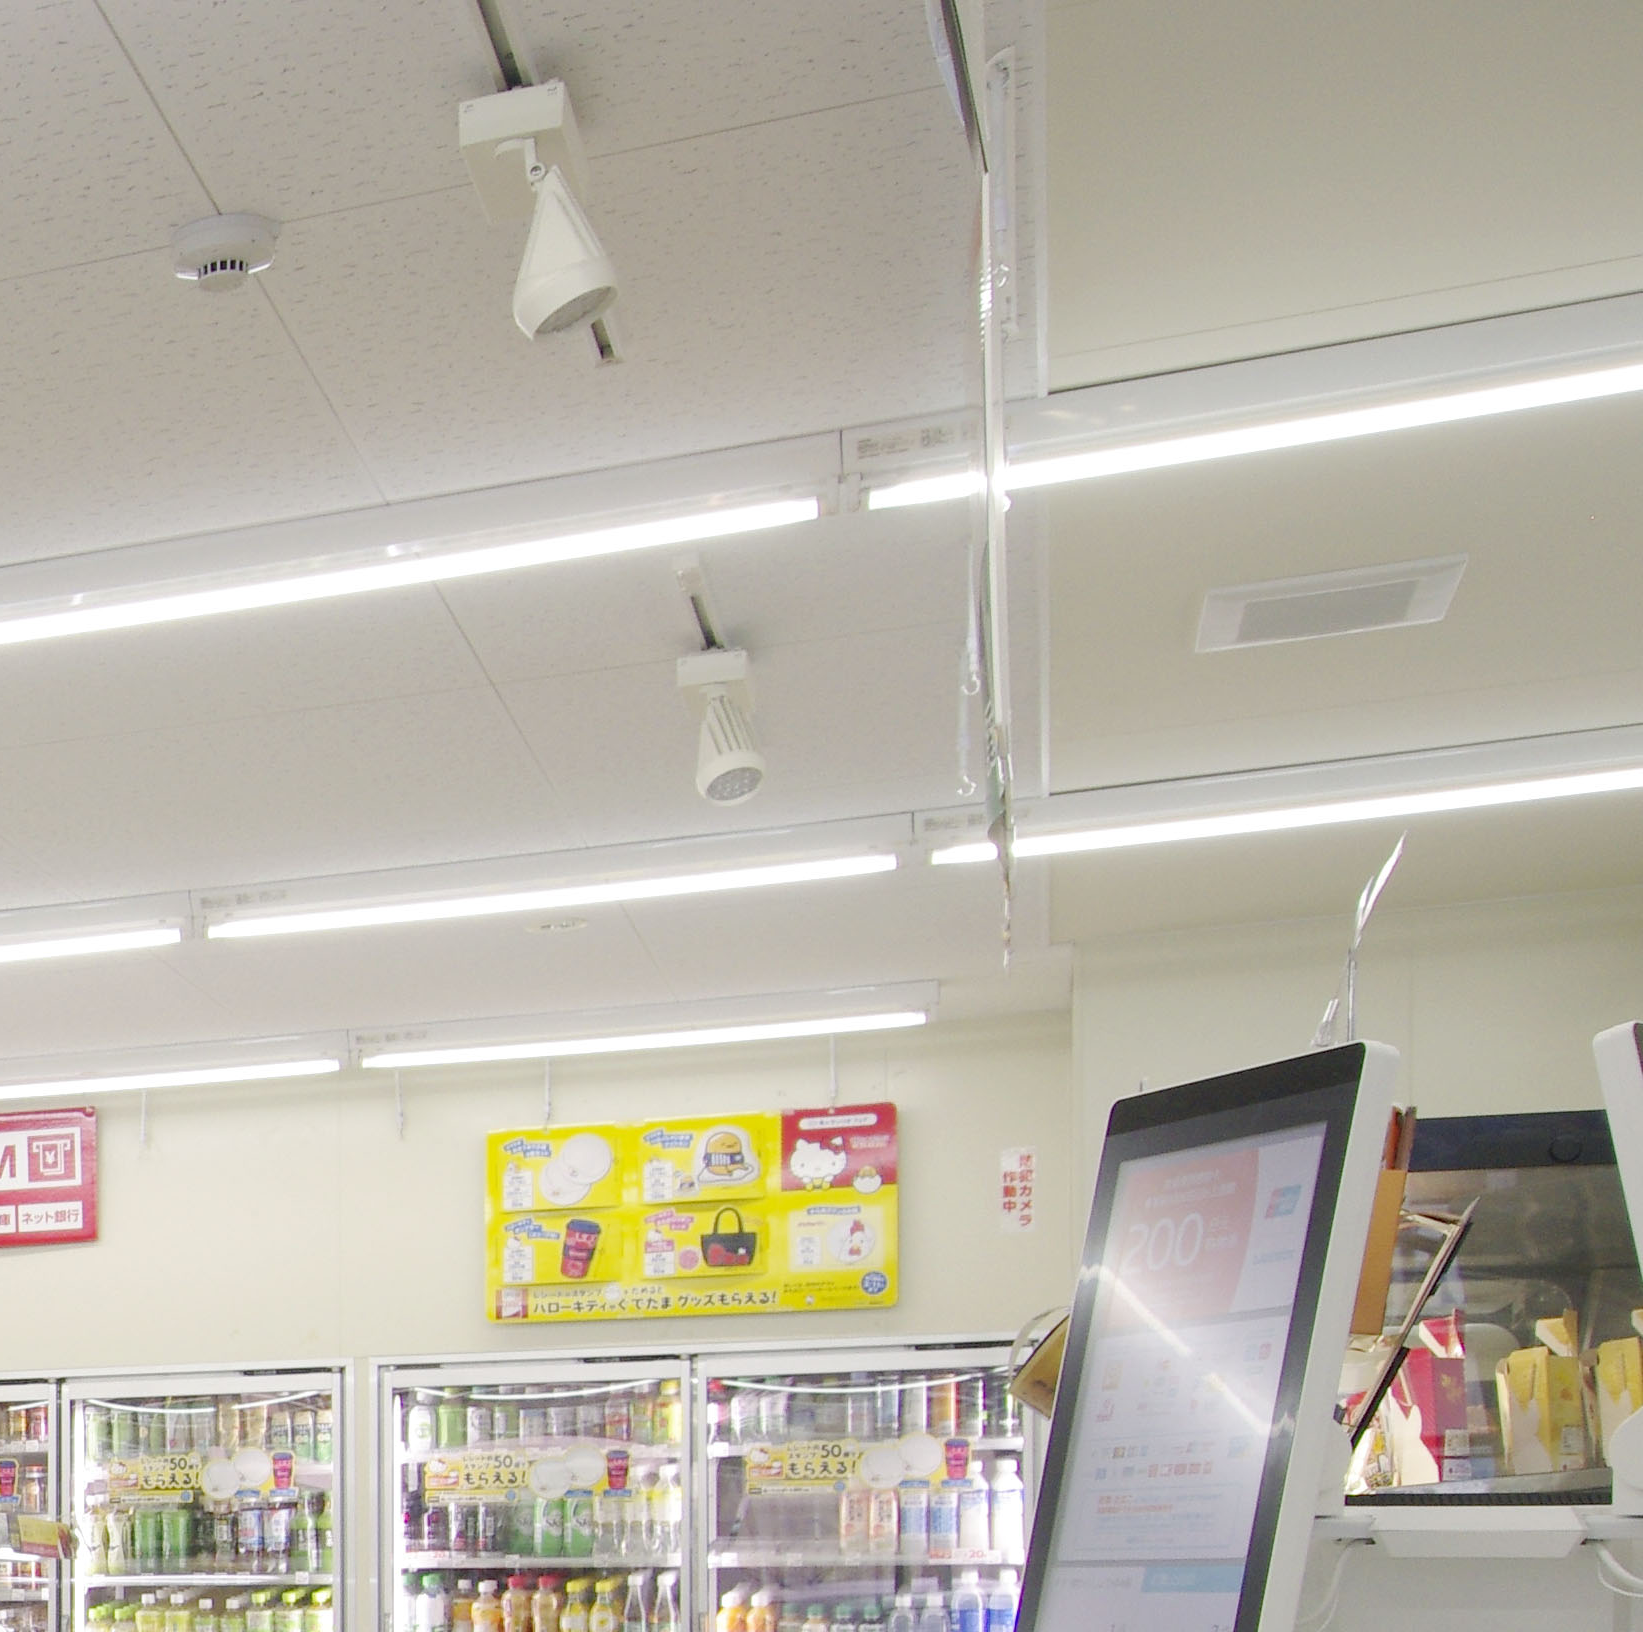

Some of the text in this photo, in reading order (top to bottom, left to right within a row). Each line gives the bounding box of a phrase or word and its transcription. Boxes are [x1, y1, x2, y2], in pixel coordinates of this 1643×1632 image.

[20, 1207, 82, 1226] ネット銀行
[1001, 1169, 1017, 1214] 作動中
[1018, 1154, 1032, 1226] 防犯カメラ
[1119, 1211, 1205, 1276] 200
